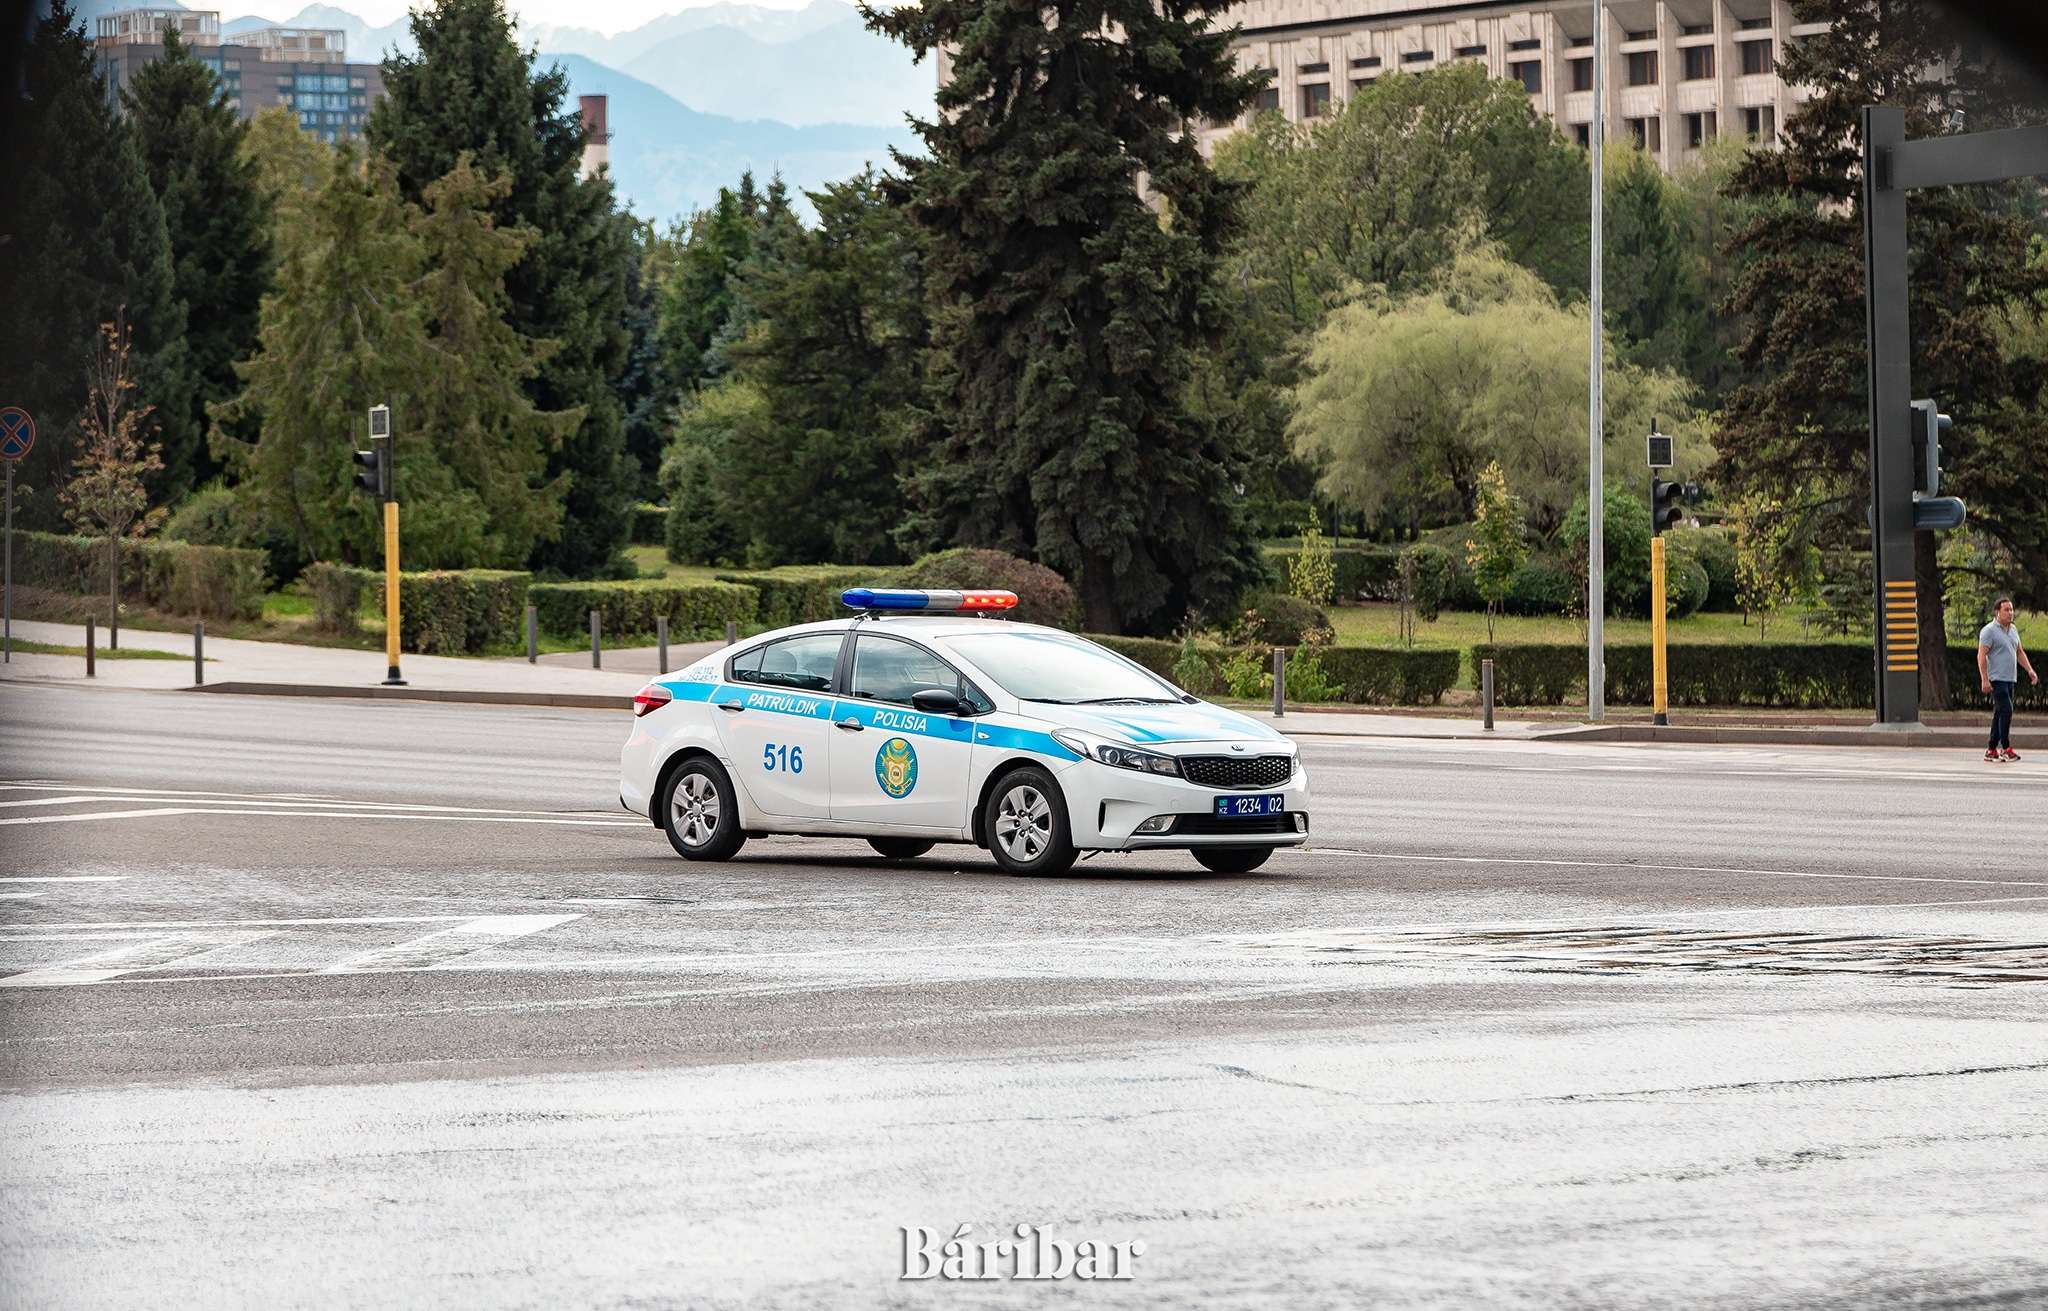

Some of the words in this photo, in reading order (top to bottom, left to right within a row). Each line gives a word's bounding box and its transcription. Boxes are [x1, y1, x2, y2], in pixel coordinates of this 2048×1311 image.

[747, 693, 820, 715] PATRÚLDIK
[872, 710, 927, 732] POLISIA
[763, 743, 803, 774] 516
[1236, 798, 1261, 813] 1234
[1270, 797, 1282, 812] 02
